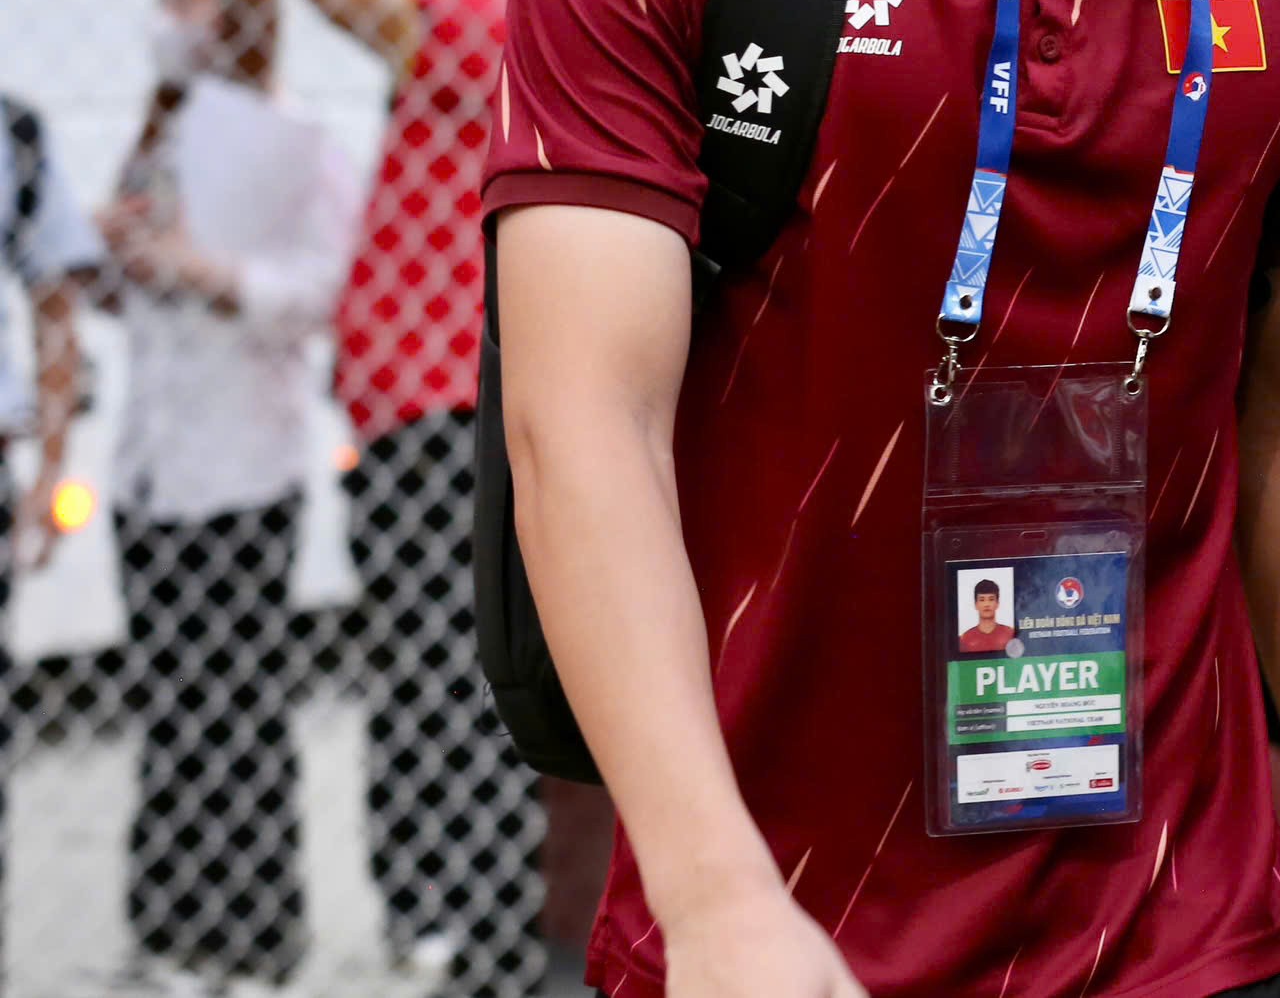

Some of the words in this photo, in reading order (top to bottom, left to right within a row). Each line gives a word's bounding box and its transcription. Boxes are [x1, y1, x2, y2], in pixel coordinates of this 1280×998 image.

[989, 61, 1012, 115] VFF
[706, 113, 782, 145] JOGARBOLA
[975, 660, 1099, 696] PLAYER
